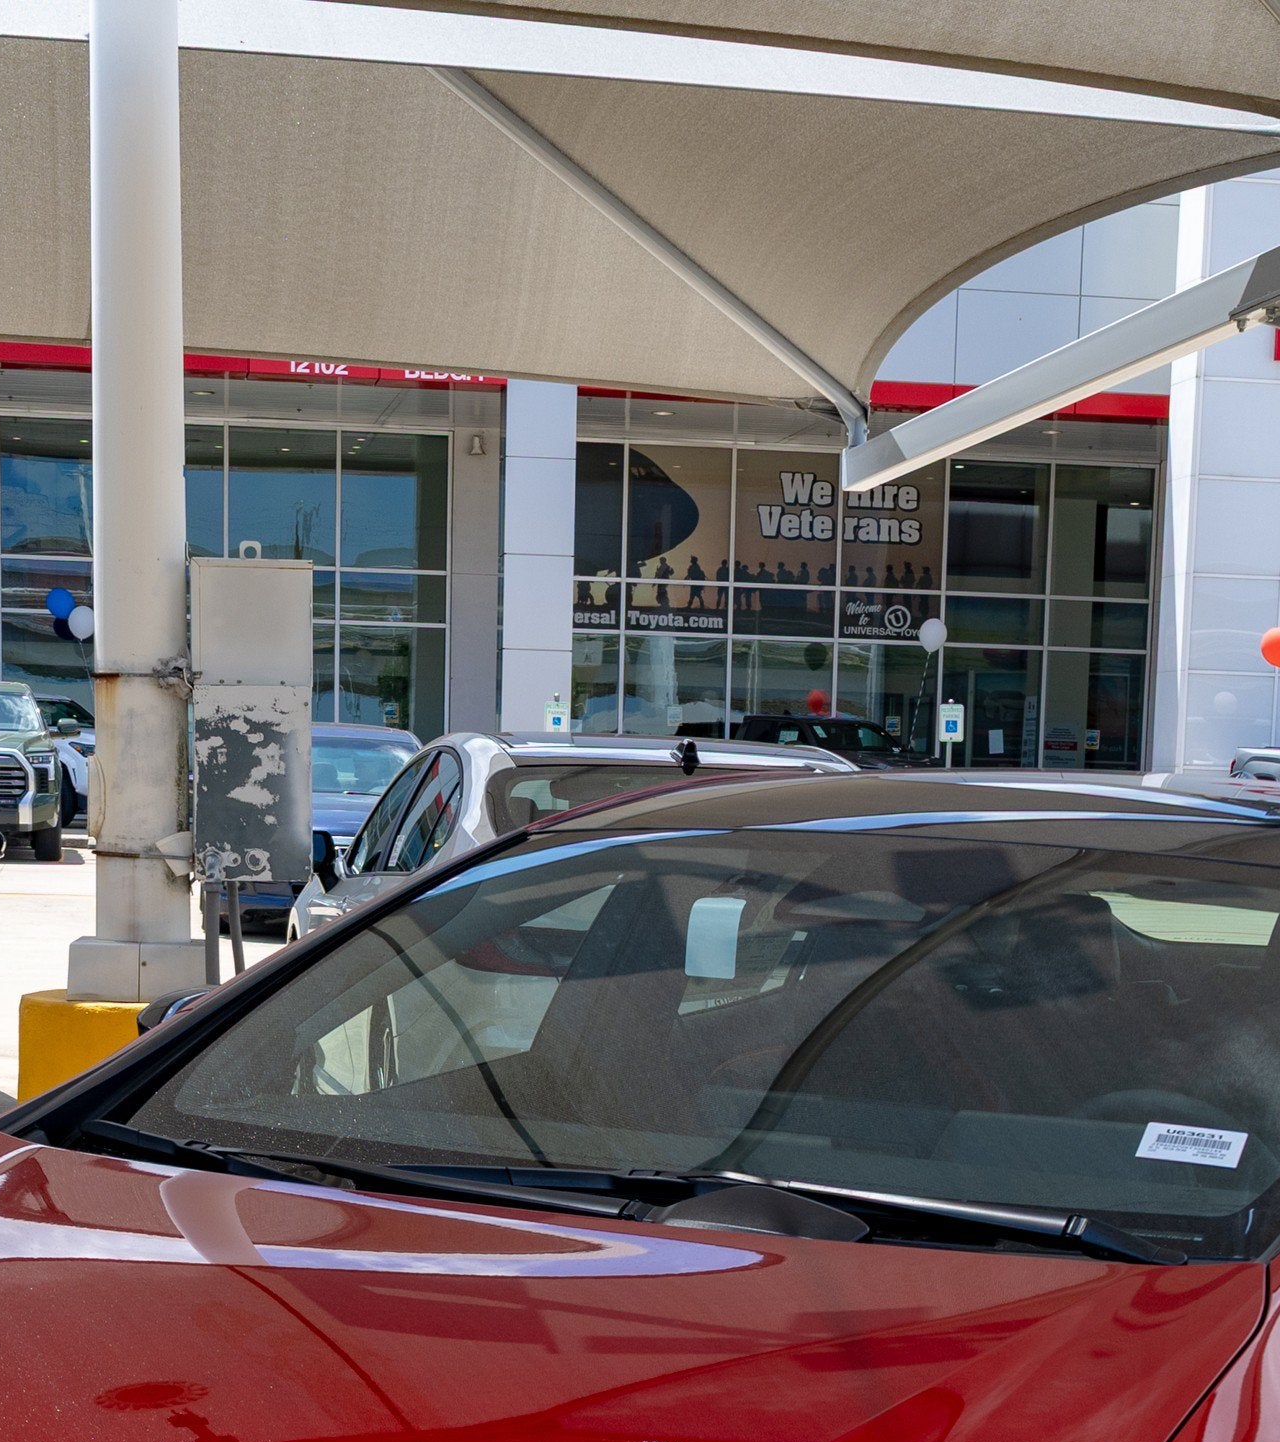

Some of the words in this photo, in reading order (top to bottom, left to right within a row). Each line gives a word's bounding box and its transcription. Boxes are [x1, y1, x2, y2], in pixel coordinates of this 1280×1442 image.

[780, 471, 834, 506] We
[757, 504, 921, 545] Veterans
[573, 609, 617, 625] ersal
[627, 610, 724, 629] Toyota.com
[843, 626, 897, 637] UNIVERSAL
